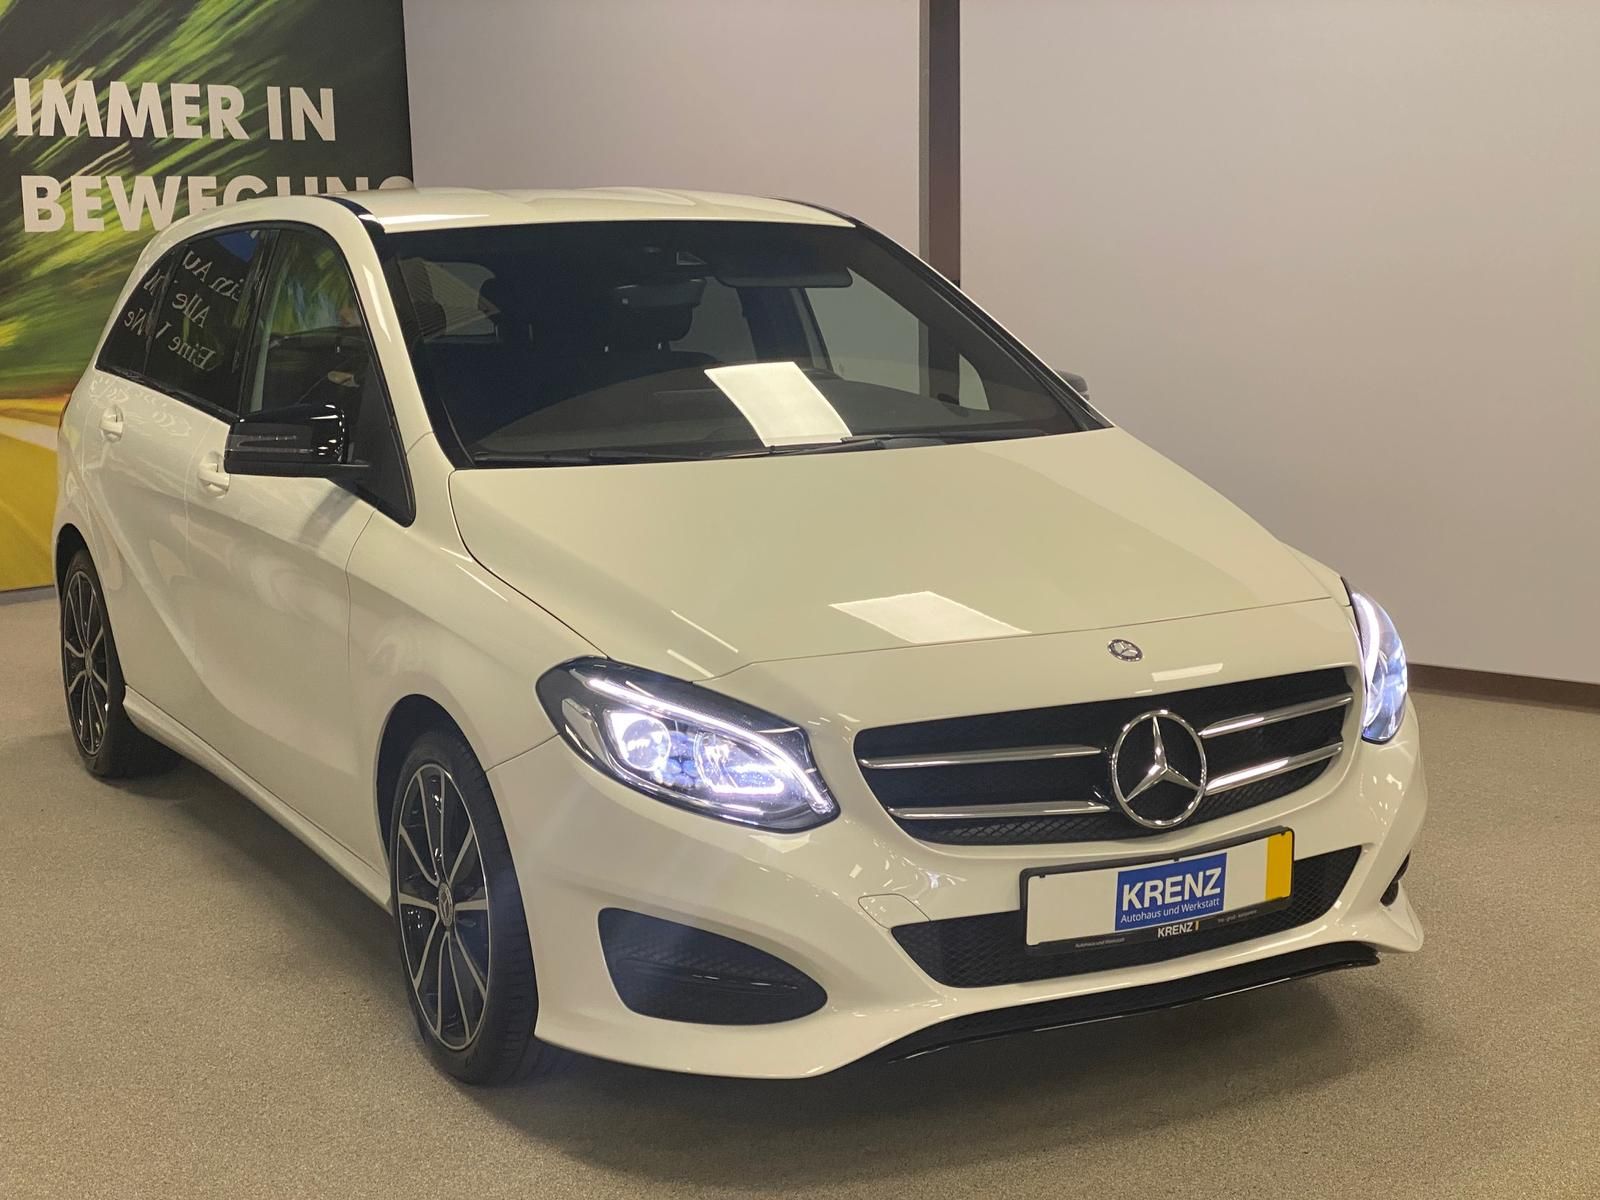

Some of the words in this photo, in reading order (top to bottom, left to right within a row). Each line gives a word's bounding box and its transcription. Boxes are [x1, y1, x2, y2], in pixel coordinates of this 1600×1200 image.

[13, 78, 249, 140] IMMER
[267, 86, 336, 142] IN
[21, 174, 414, 233] BEWE
[1120, 910, 1161, 924] Autohaus
[1163, 903, 1180, 917] und
[1180, 898, 1220, 913] Werkstatt
[1122, 867, 1222, 911] KRENZ
[1157, 921, 1193, 938] KRENZ
